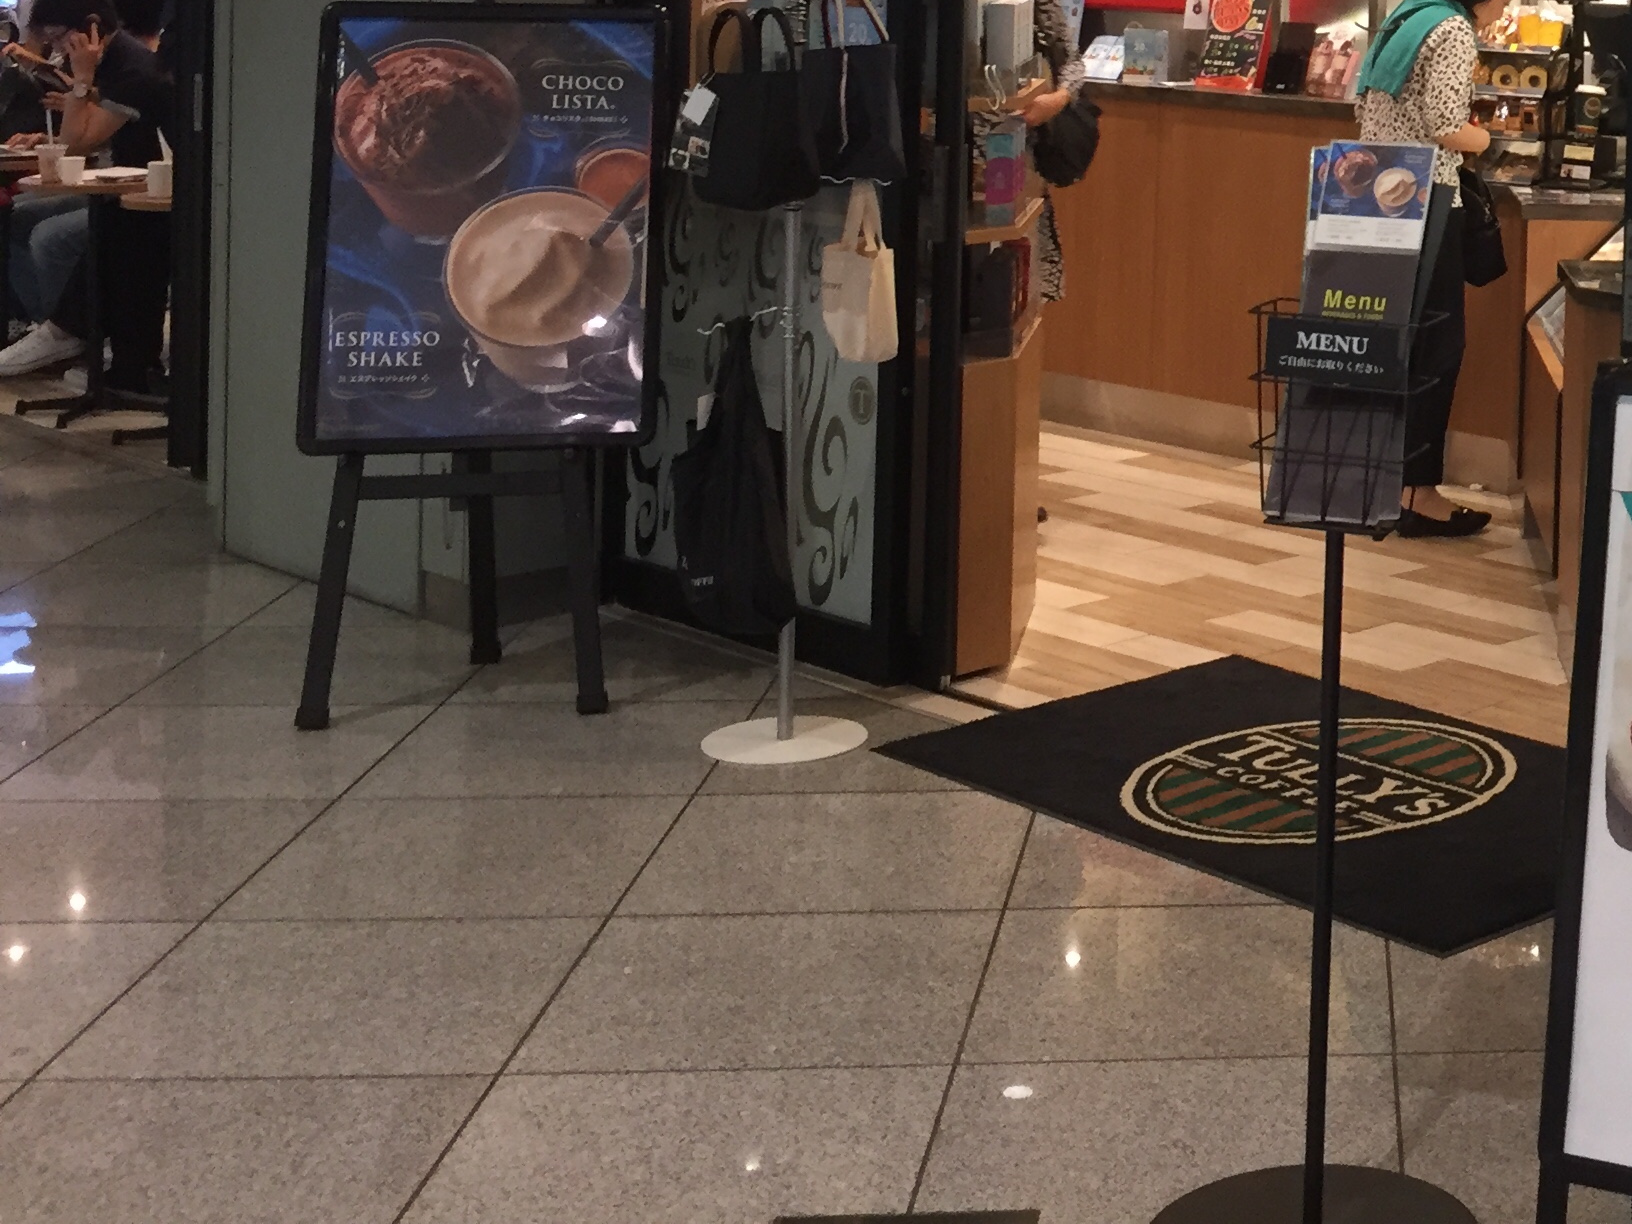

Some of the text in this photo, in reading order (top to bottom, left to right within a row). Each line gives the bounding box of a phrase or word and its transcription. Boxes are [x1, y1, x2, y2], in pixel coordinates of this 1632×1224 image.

[541, 74, 625, 91] CHOCO
[1323, 288, 1388, 312] Menu
[334, 330, 441, 347] ESPRESSO
[1296, 331, 1370, 355] MENU
[346, 351, 424, 367] SHAKE
